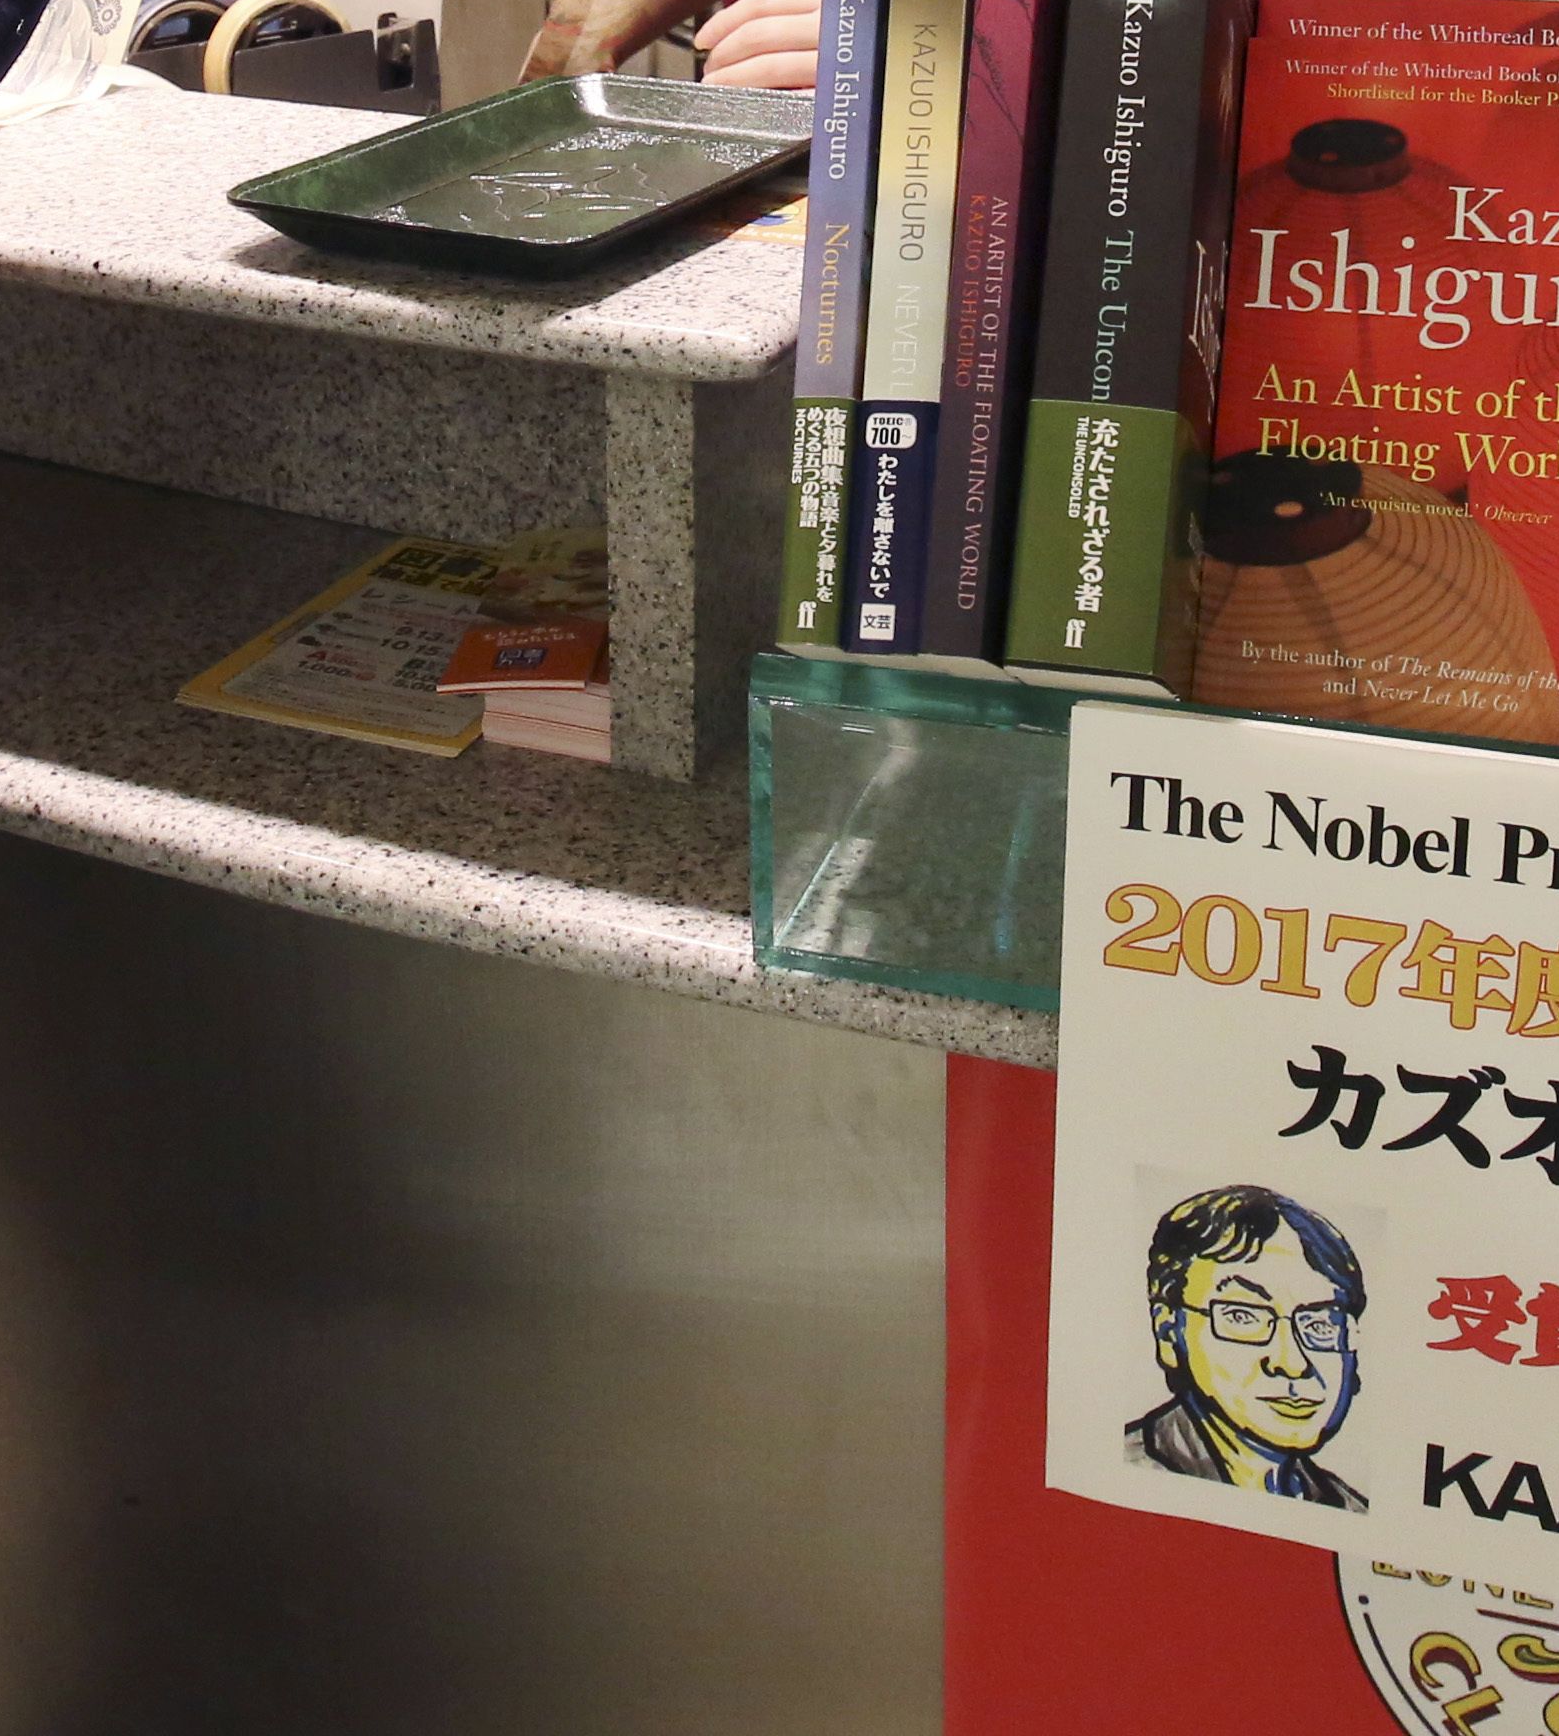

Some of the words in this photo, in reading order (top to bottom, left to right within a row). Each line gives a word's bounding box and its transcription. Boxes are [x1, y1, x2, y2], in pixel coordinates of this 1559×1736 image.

[908, 22, 939, 119] KAZUO
[1288, 17, 1364, 41] Winner
[1366, 21, 1390, 41] of
[1392, 22, 1424, 42] the
[1428, 23, 1535, 48] Whitbread
[823, 70, 862, 182] Ishiguro
[1326, 83, 1416, 104] Shortlisted
[1420, 85, 1446, 104] for
[1448, 87, 1478, 105] the
[1480, 87, 1543, 108] Booker
[898, 125, 932, 264] ISHIGURO
[1103, 95, 1148, 219] Ishiguro
[965, 194, 986, 273] KAZUO
[991, 196, 1010, 228] AN
[815, 221, 851, 366] Nocturnes
[982, 233, 1004, 309] ARTIST
[1100, 229, 1135, 292] The
[954, 278, 980, 389] ISHIGURO
[981, 313, 1003, 342] OF
[975, 347, 998, 394] THE
[1252, 363, 1319, 405] An
[1331, 368, 1462, 417] Artist
[1475, 378, 1527, 420] of
[790, 407, 807, 485] NOCTURNES
[965, 400, 994, 514] FLOATING
[1076, 416, 1091, 443] THE
[1255, 416, 1441, 483] Floating
[1068, 443, 1089, 520] UNCONSOLED
[1073, 417, 1122, 613] 充たされざる者
[869, 452, 900, 600] わたしを離さないで
[956, 519, 982, 611] WORLD
[862, 613, 892, 630] 文芸
[1111, 771, 1243, 847] The
[1262, 793, 1471, 880] Nobel
